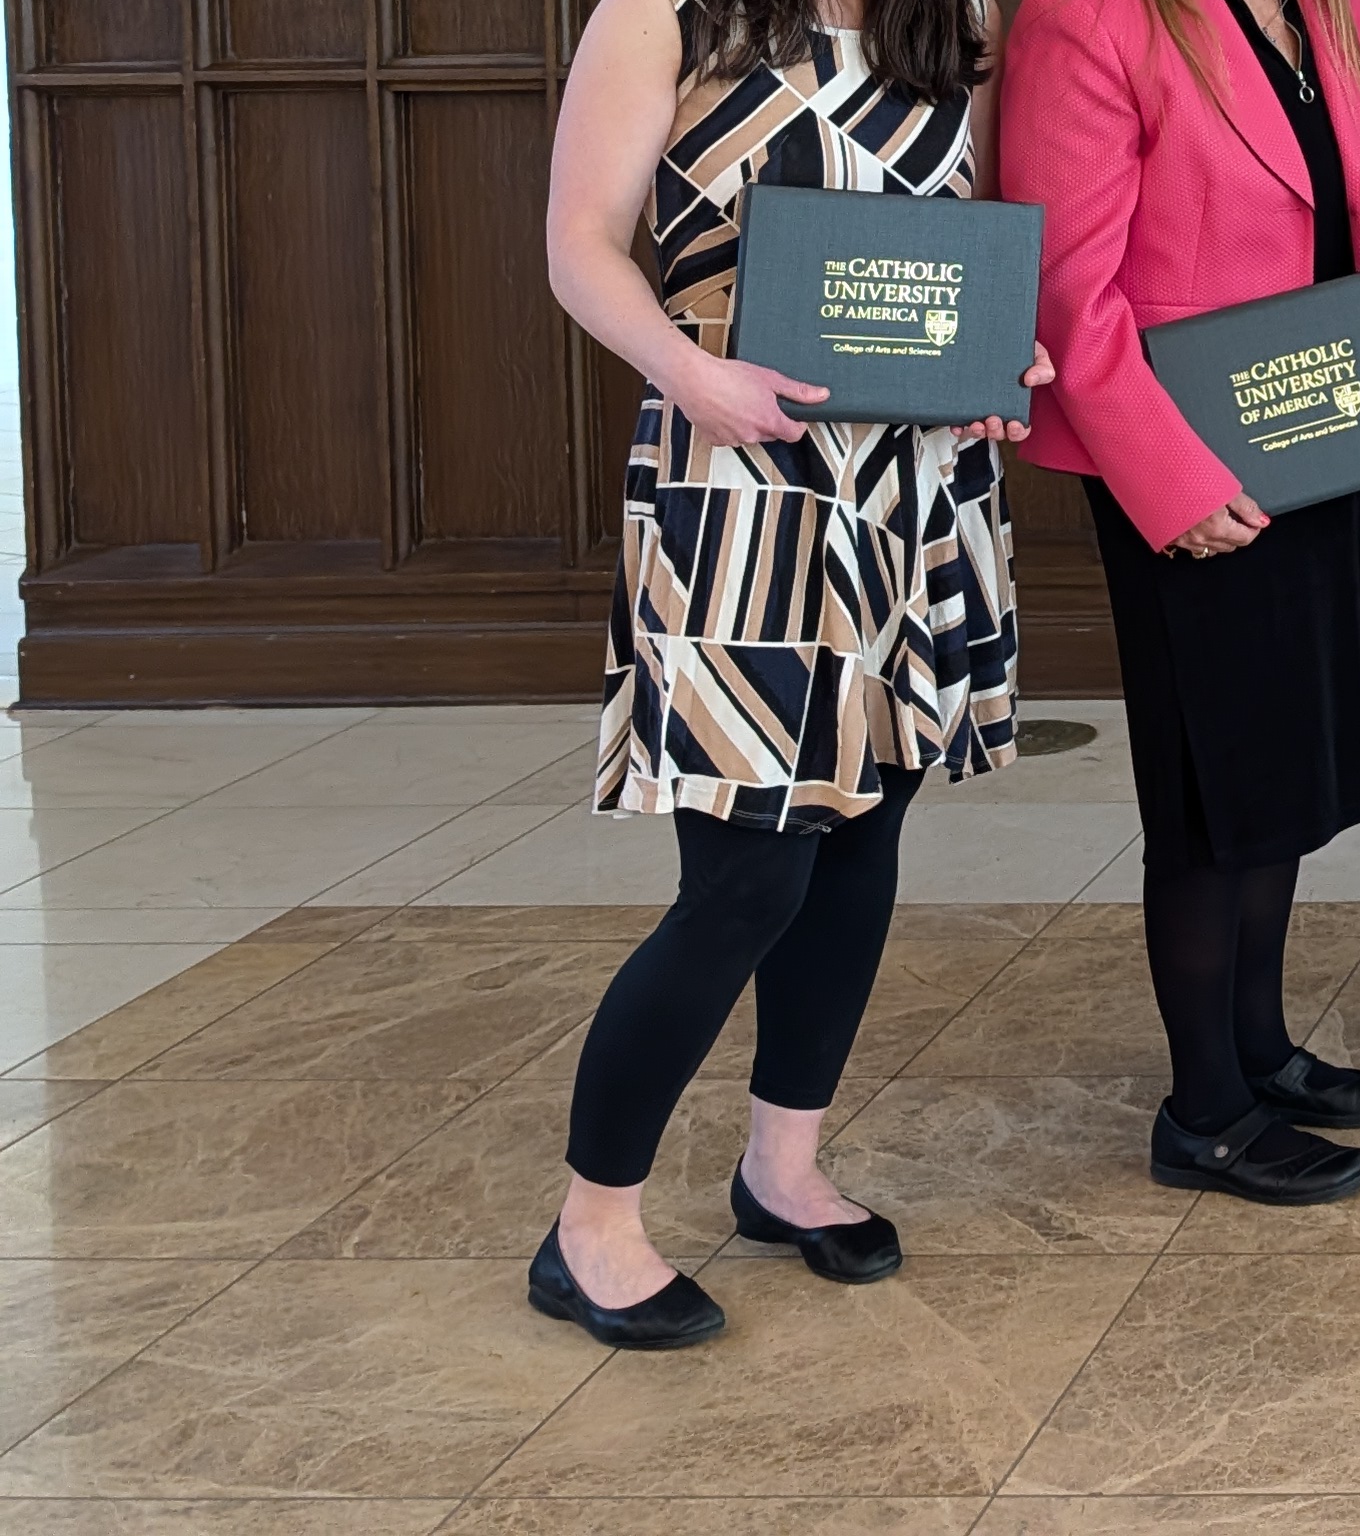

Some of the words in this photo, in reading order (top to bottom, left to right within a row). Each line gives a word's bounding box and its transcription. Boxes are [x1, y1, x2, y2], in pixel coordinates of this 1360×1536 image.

[824, 260, 847, 272] THE
[848, 257, 963, 283] CATHOLIC
[823, 280, 961, 306] UNIVERSITY
[820, 304, 844, 318] OF
[845, 305, 919, 322] AMERICA
[833, 343, 864, 354] College
[875, 346, 891, 354] Arts
[892, 346, 908, 355] and
[908, 347, 942, 356] Sciences
[1229, 370, 1251, 384] THE
[1250, 338, 1354, 381] CATHOLIC
[1234, 359, 1357, 408] UNIVERSITY
[1240, 409, 1261, 425] OF
[1263, 391, 1329, 420] AMERICA
[1262, 436, 1291, 452] College
[1299, 431, 1314, 441] Arts
[1314, 426, 1329, 438] and
[1328, 419, 1359, 433] Sciences
